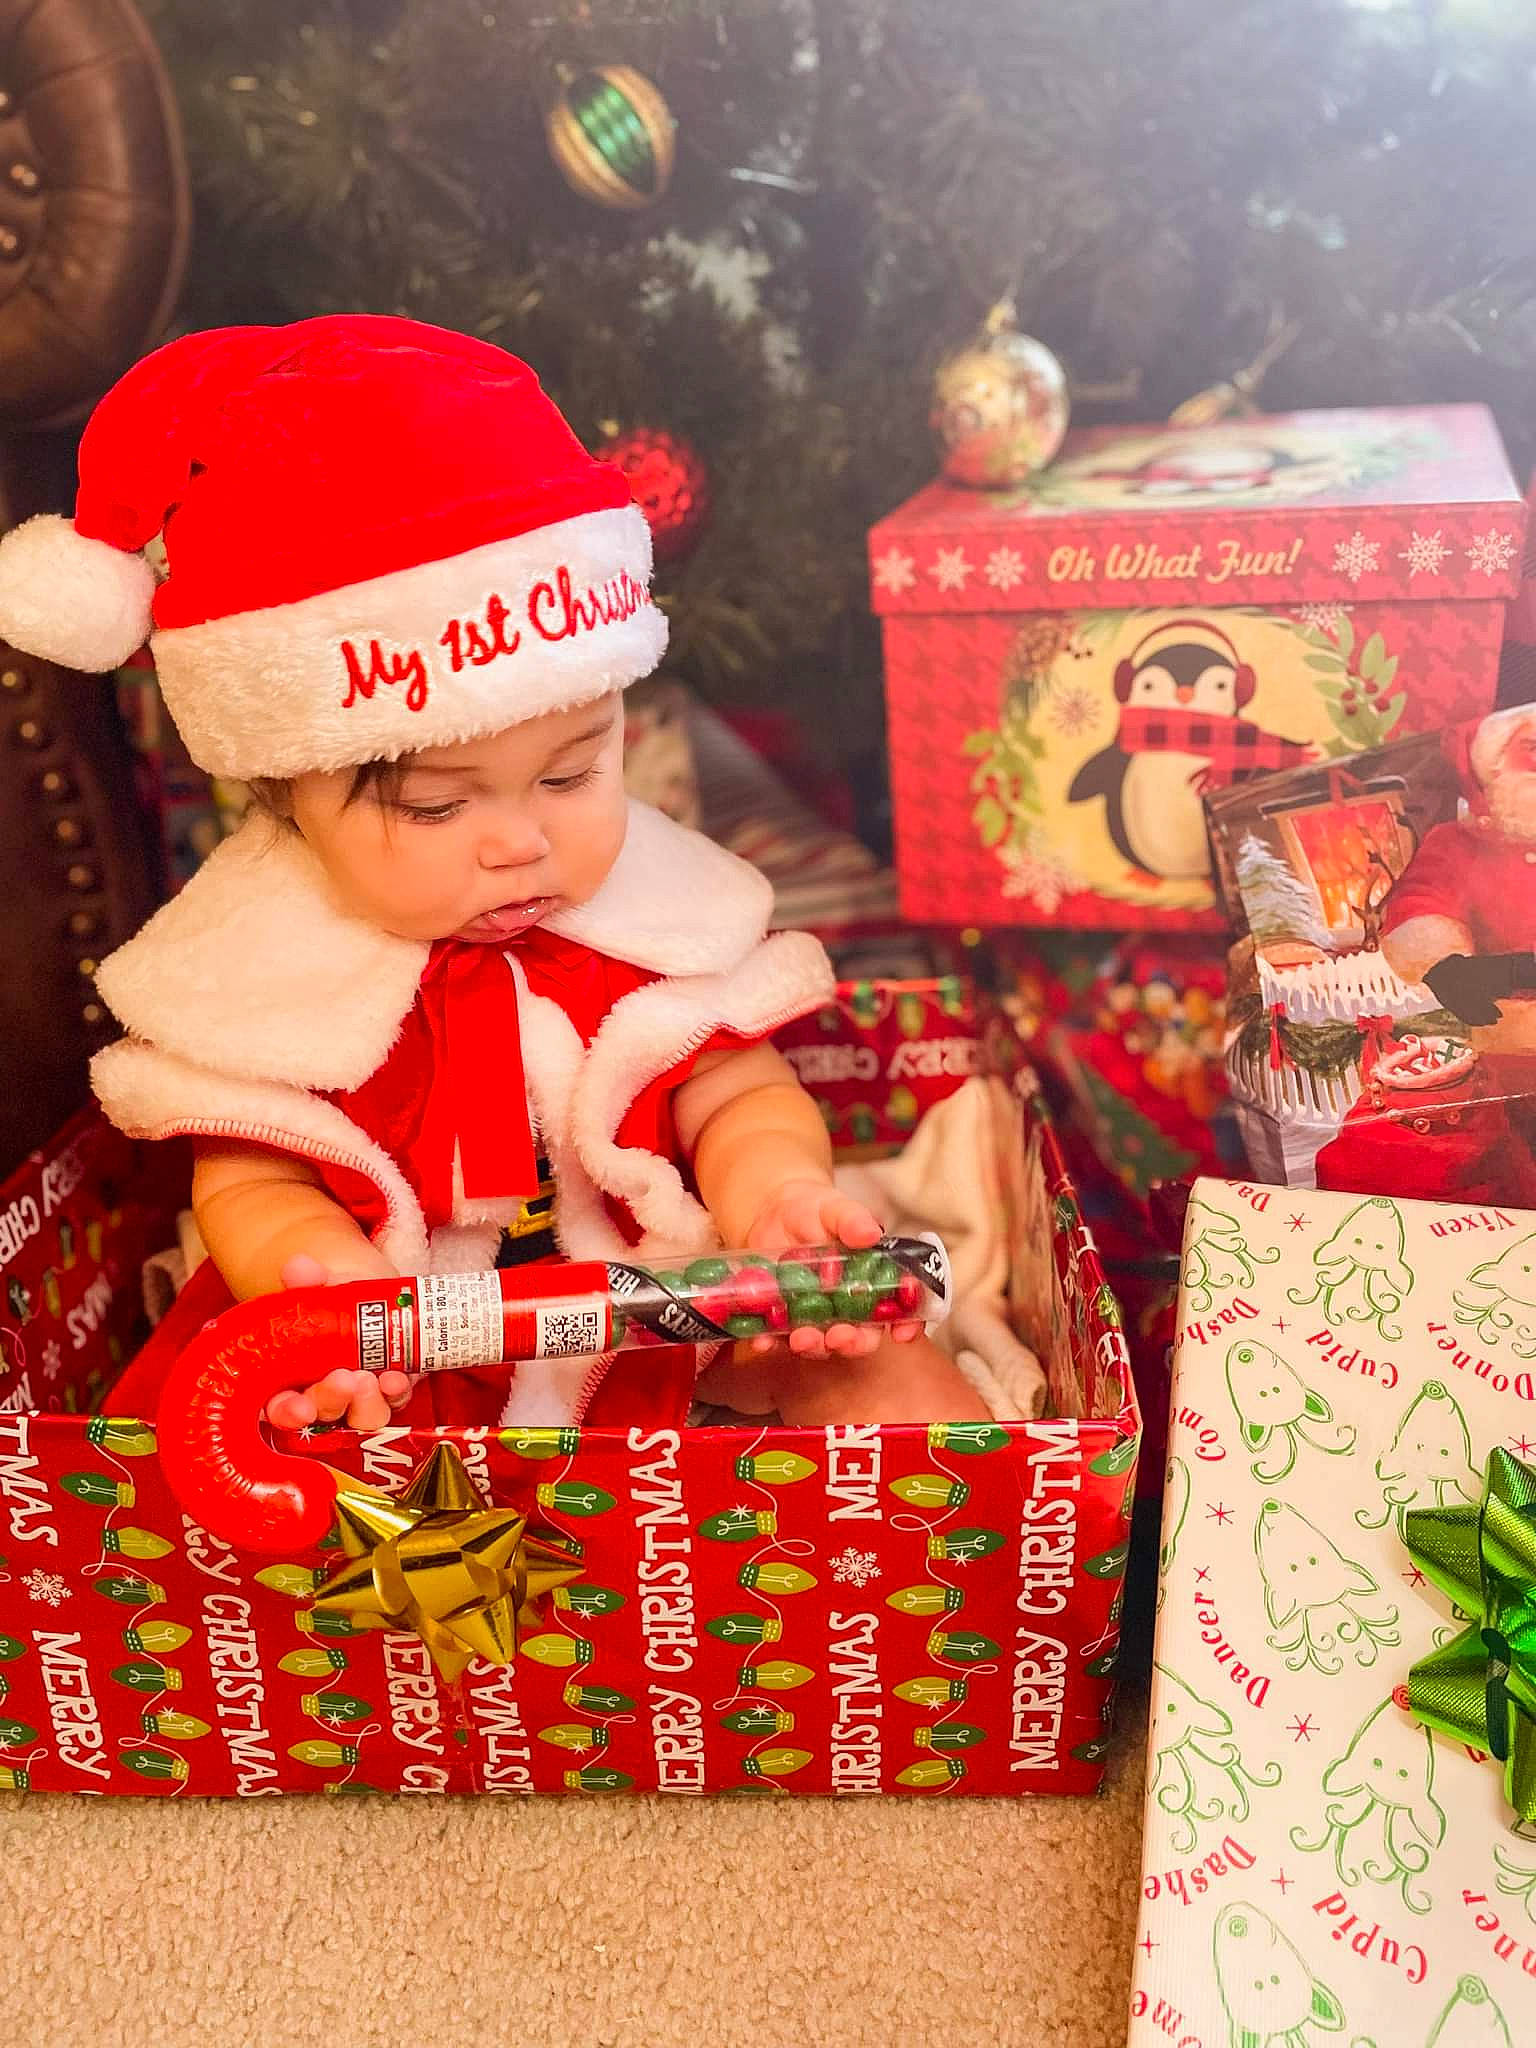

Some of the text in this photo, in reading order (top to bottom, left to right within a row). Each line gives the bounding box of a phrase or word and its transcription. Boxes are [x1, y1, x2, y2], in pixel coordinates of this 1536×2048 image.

[1047, 537, 1304, 584] Oh What Fun!
[341, 640, 429, 712] My
[440, 593, 521, 672] 1st
[1431, 1208, 1517, 1239] Vixen
[1305, 1328, 1399, 1390] Cupid
[1427, 1321, 1536, 1401] Donner
[628, 1427, 695, 1673] CHRISTMAS
[1009, 1627, 1069, 1772] MERRY
[1194, 1591, 1271, 1709] Dancer
[32, 1629, 112, 1780] MERRY
[1312, 1890, 1429, 1984] Cupid
